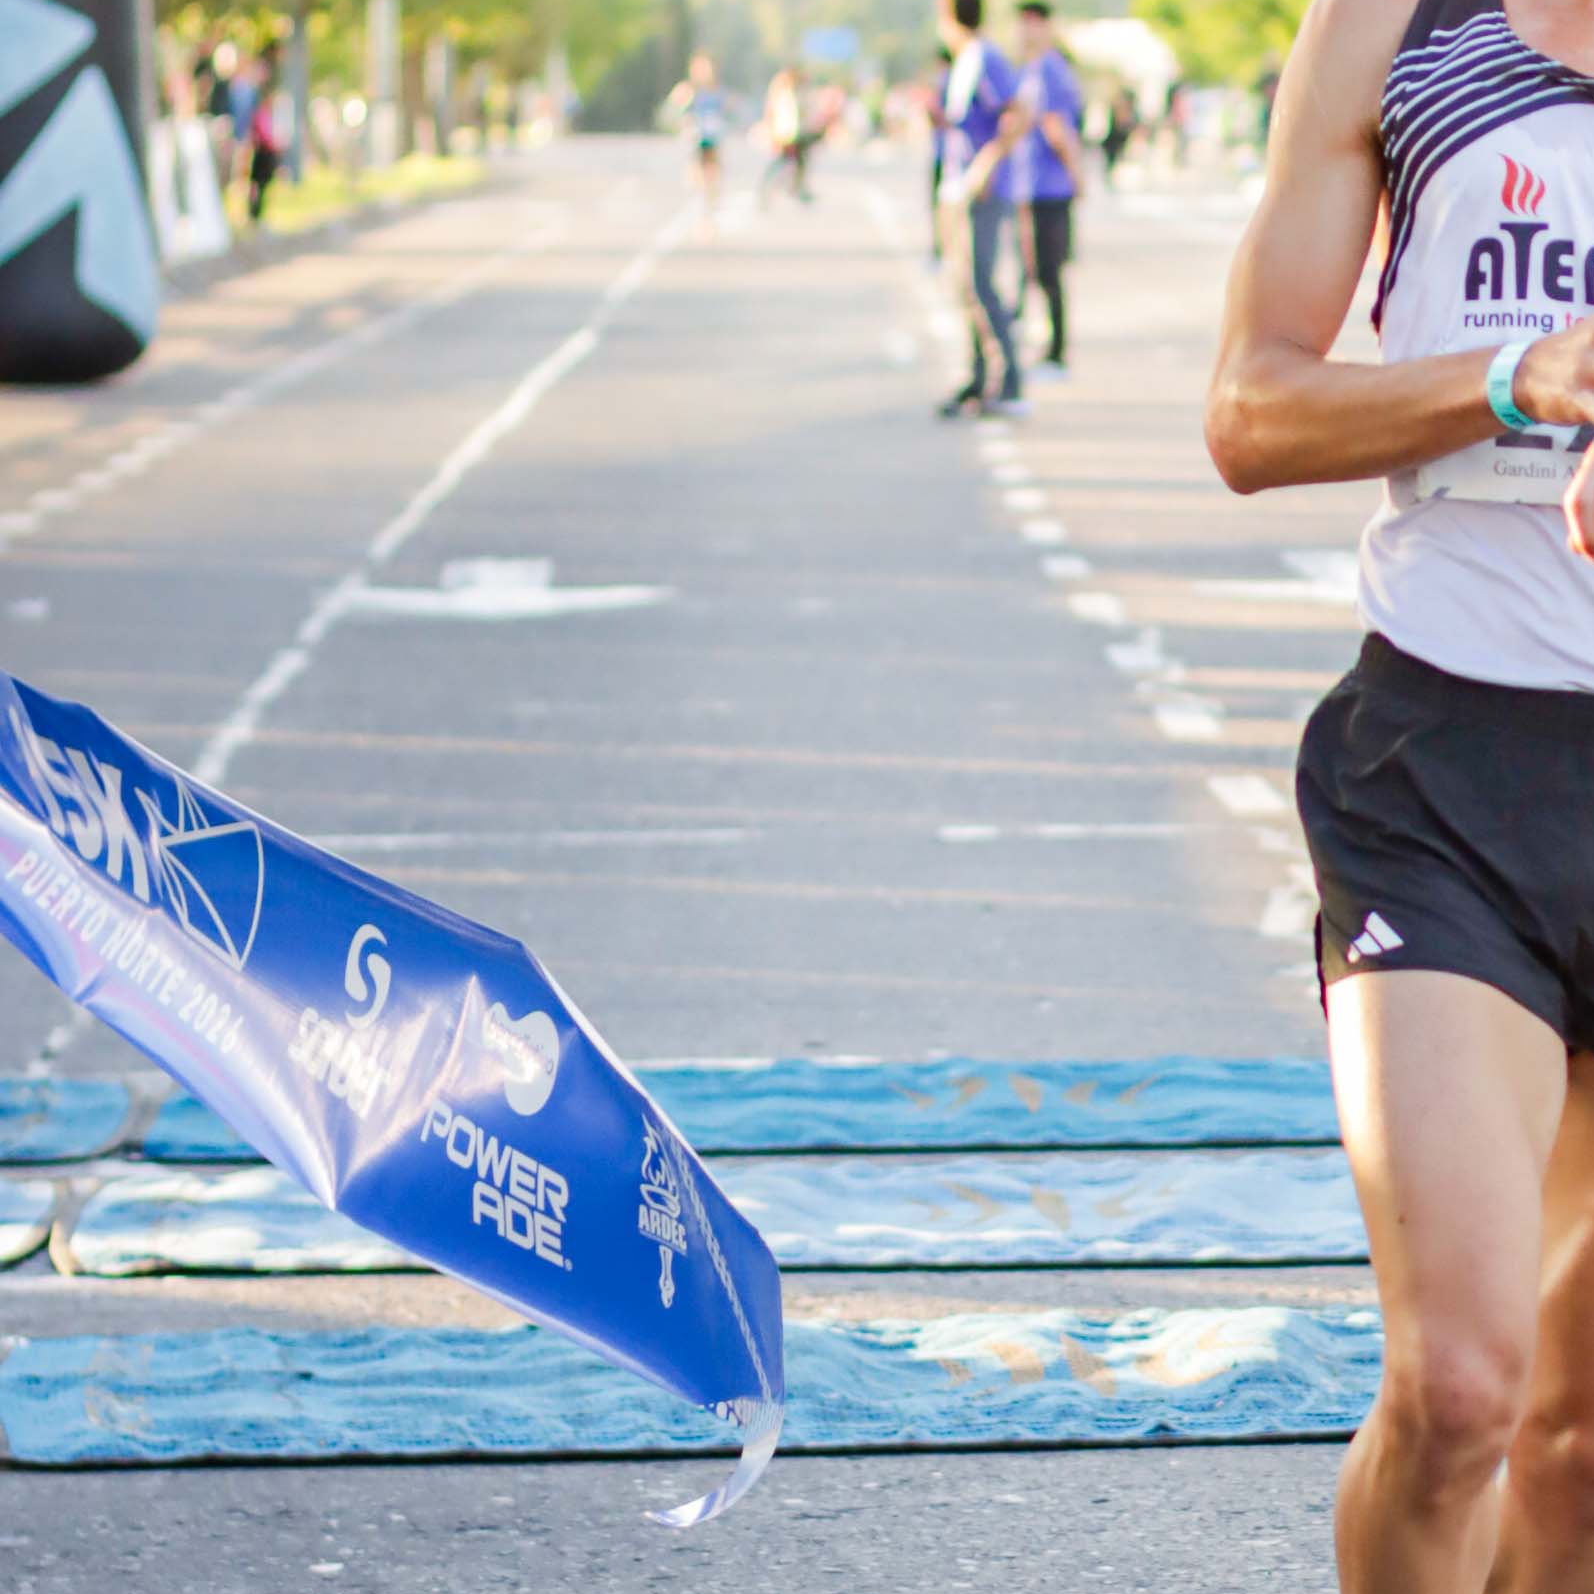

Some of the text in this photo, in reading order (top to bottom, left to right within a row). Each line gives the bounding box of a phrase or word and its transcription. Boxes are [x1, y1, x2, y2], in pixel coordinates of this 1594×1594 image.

[1464, 308, 1554, 333] running
[6, 849, 244, 1055] PUERTO NORTE 2026
[421, 1098, 569, 1223] POWER
[638, 1204, 687, 1252] ARDEC
